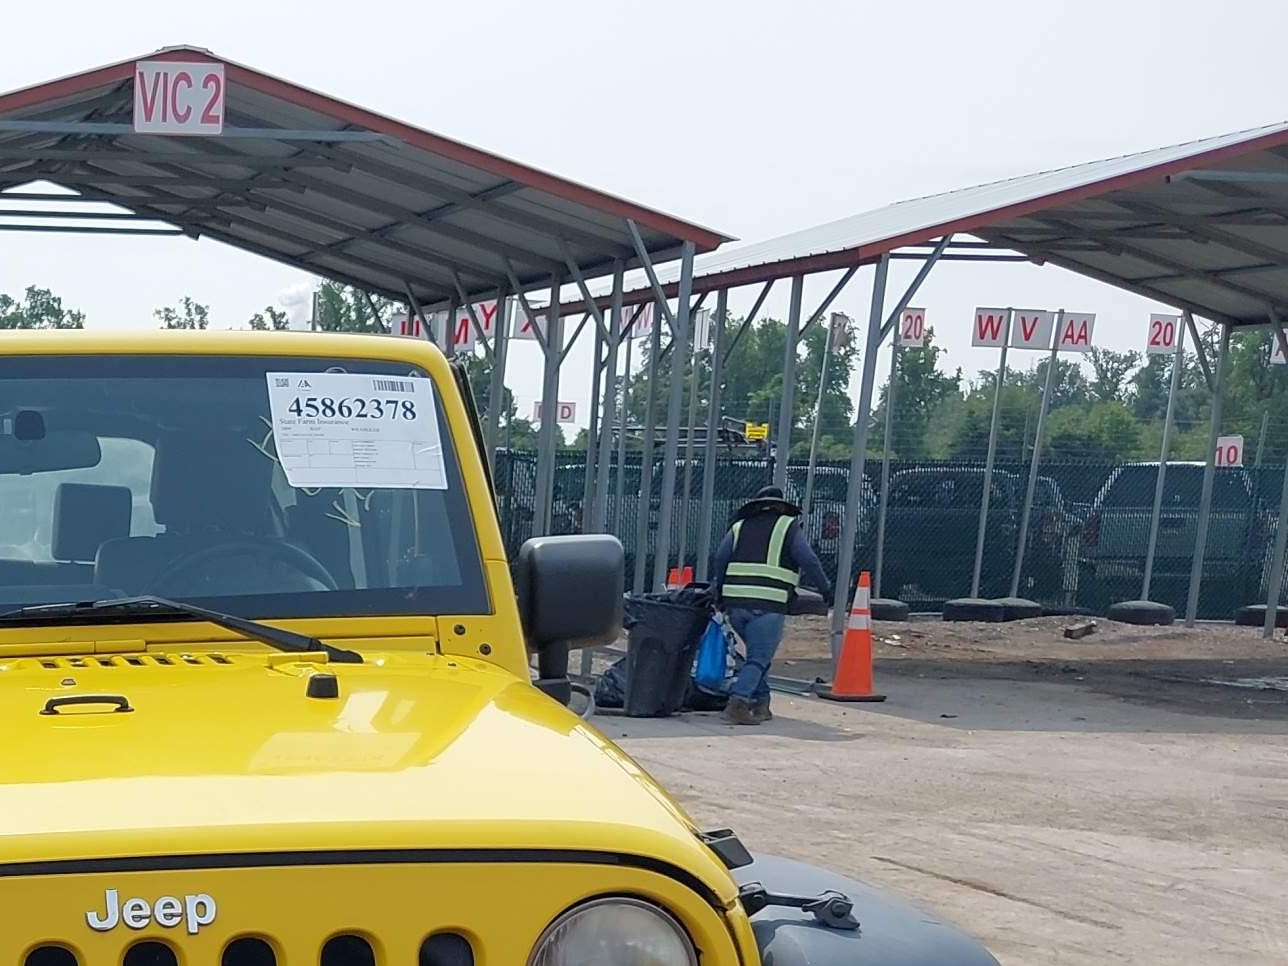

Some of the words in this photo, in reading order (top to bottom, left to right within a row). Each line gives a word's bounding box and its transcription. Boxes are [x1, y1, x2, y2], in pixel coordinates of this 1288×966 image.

[138, 71, 192, 124] VIC
[200, 73, 222, 124] 2
[479, 304, 498, 330] Y
[903, 314, 923, 340] 20
[977, 315, 1003, 341] W
[1020, 316, 1039, 342] V
[1061, 319, 1089, 345] AA
[1150, 320, 1174, 346] 20
[288, 397, 417, 421] 45862378
[560, 405, 572, 419] D
[1216, 445, 1238, 465] 10
[85, 888, 217, 935] Jeep
